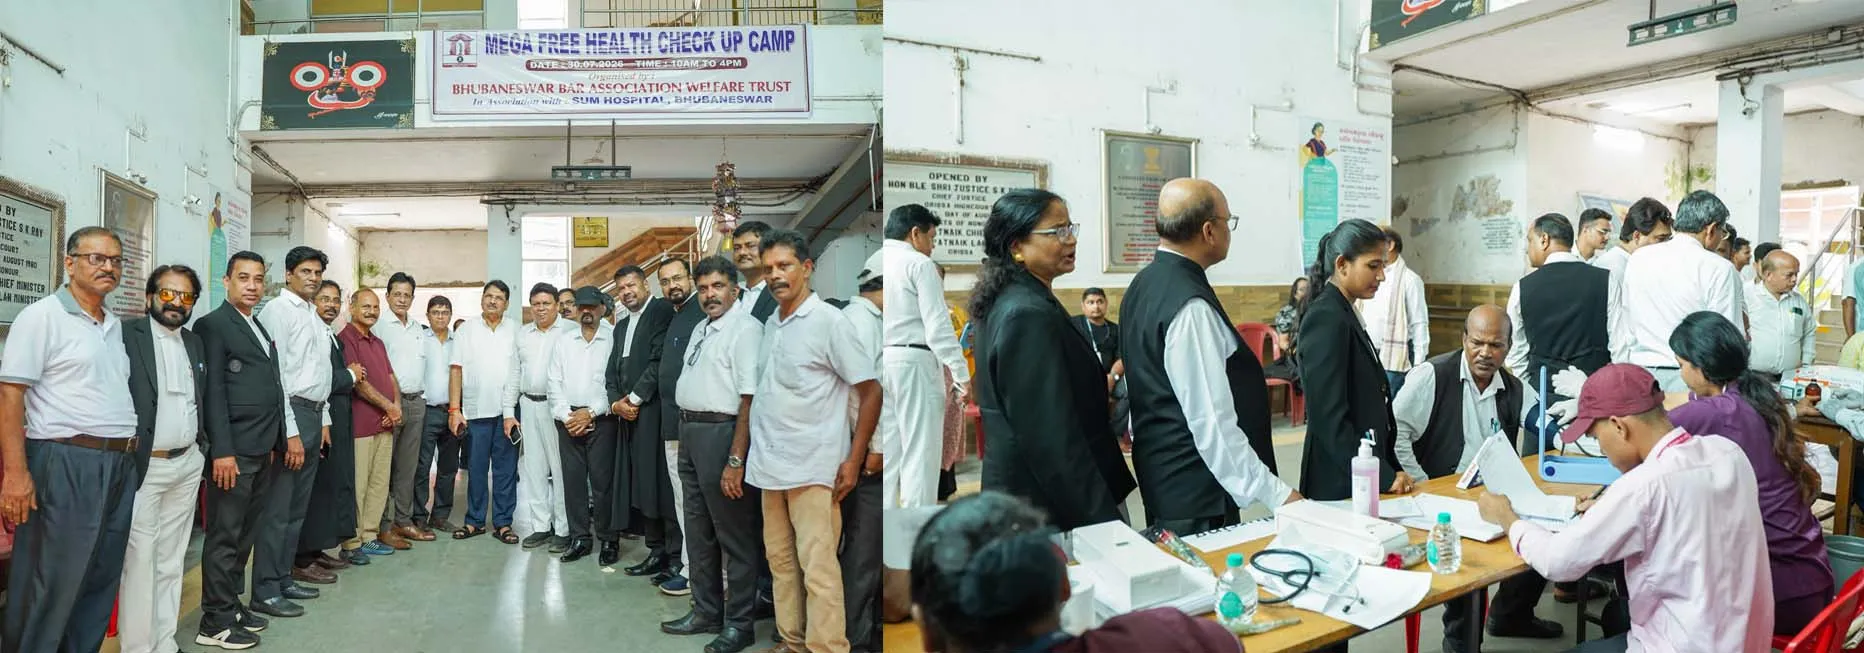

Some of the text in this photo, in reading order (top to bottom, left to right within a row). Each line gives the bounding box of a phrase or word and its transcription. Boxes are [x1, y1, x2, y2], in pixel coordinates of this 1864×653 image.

[485, 30, 795, 55] MEGA FREE HEALTH CHECK UP CAMP
[530, 61, 558, 69] DATE
[635, 60, 660, 68] TIME
[671, 59, 699, 68] 10AM
[702, 59, 716, 67] TO
[720, 58, 742, 67] 4PM
[452, 81, 792, 95] BHUBANESWAR BAR ASSOCIATION WELFARE TRUST
[472, 97, 483, 106] In
[572, 96, 600, 105] SUM
[674, 95, 773, 104] BHUBANESWAR
[928, 172, 988, 183] OPENED BY
[930, 182, 951, 191] SHRI
[953, 184, 989, 194] JUSTICE
[956, 194, 987, 202] JUSTICE
[6, 205, 17, 217] BY
[934, 239, 968, 247] ATNAIK
[3, 255, 25, 267] AUGUST
[16, 279, 46, 293] MINISTER
